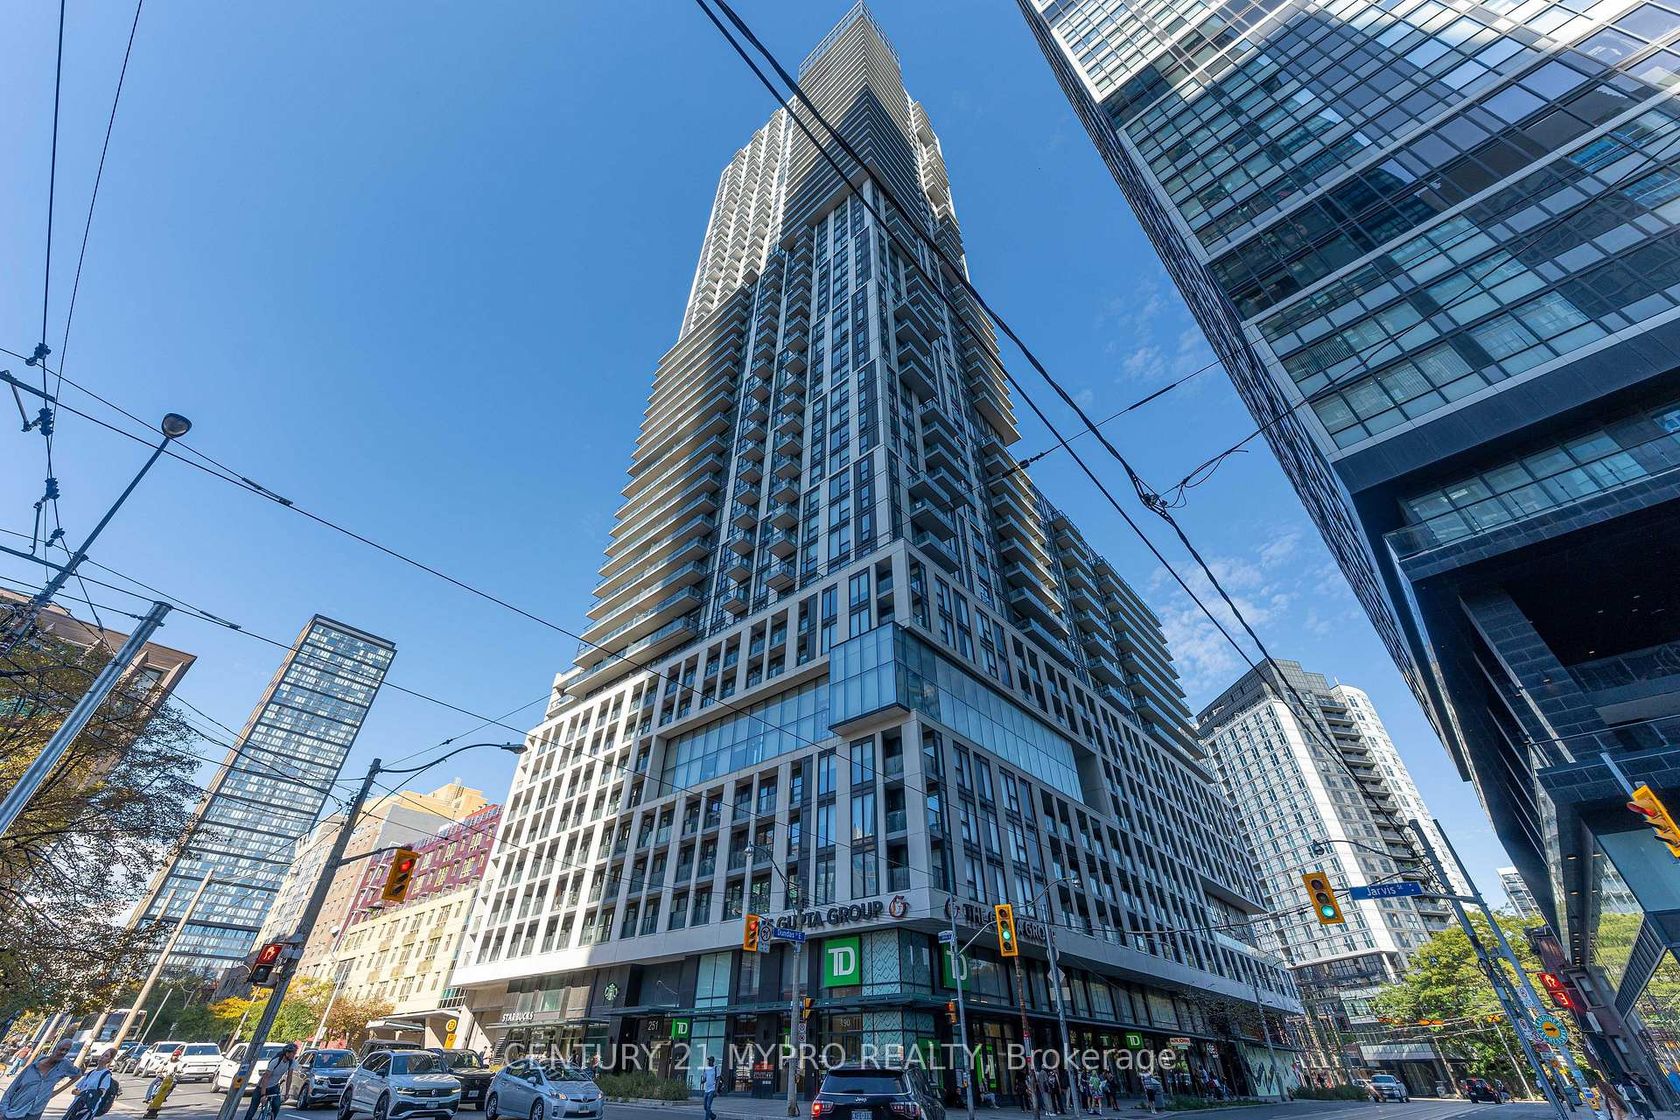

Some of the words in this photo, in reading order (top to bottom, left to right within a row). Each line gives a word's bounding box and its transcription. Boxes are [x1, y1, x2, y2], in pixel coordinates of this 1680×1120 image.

[1366, 885, 1397, 897] Jarvis
[826, 901, 884, 926] GROUP
[777, 928, 795, 940] Dundas
[827, 945, 856, 977] TD
[647, 1020, 659, 1031] 251
[677, 1021, 688, 1035] TD
[1126, 1035, 1140, 1046] TD
